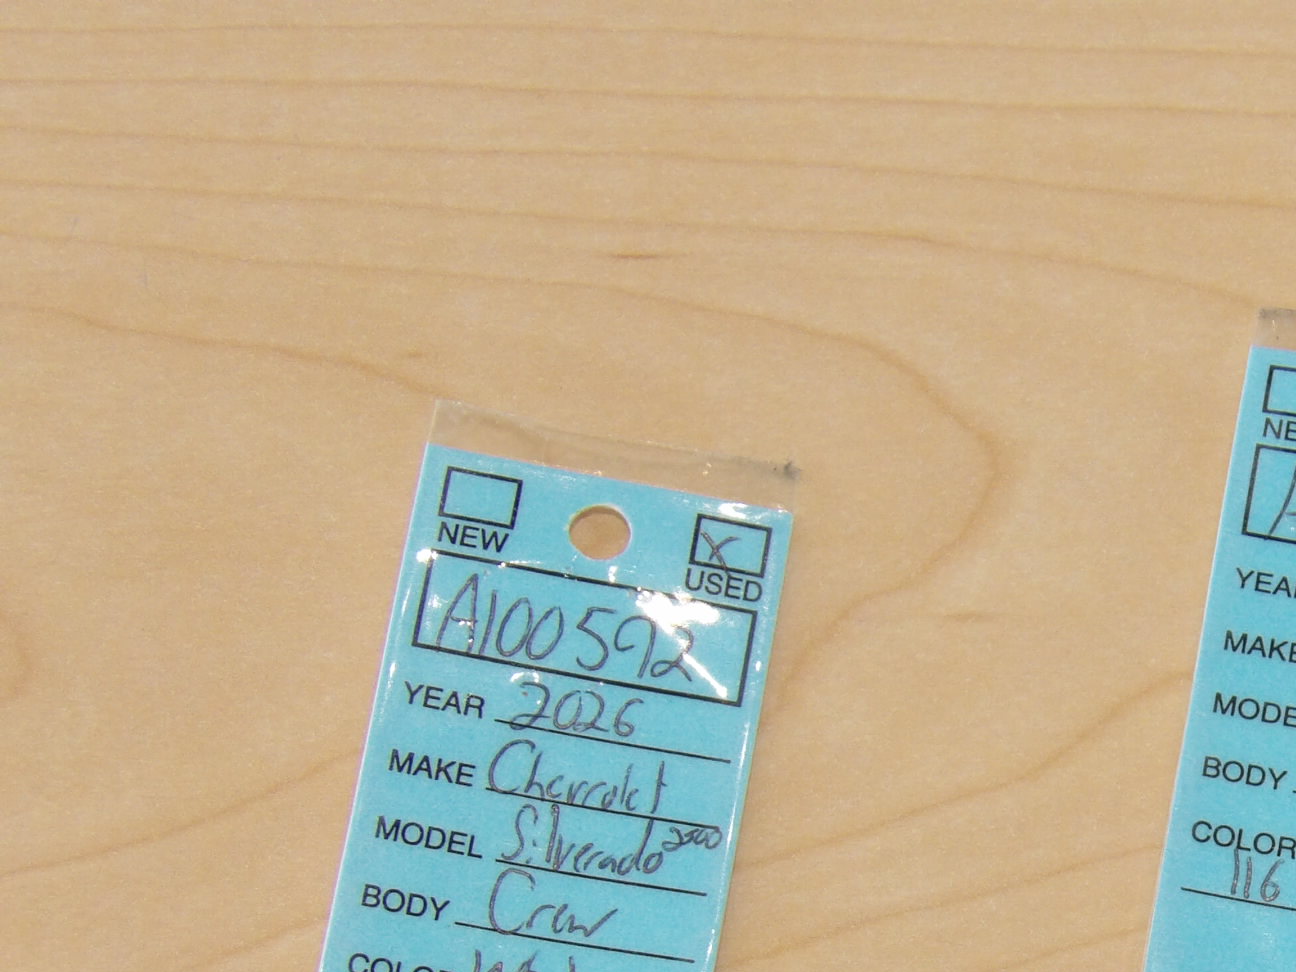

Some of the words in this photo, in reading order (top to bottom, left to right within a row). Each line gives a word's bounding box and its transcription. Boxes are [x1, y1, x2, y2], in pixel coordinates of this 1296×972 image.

[438, 522, 509, 553] NEW
[685, 567, 763, 601] USED
[436, 573, 693, 682] A100592
[404, 681, 485, 718] YEAR
[510, 681, 644, 737] 2026
[388, 749, 476, 786] MAKE
[1202, 756, 1287, 790] BODY
[375, 816, 482, 859] MODEL
[1191, 820, 1296, 860] COLOR
[1231, 849, 1285, 902] 116
[361, 884, 450, 921] BODY
[489, 868, 618, 935] Crew
